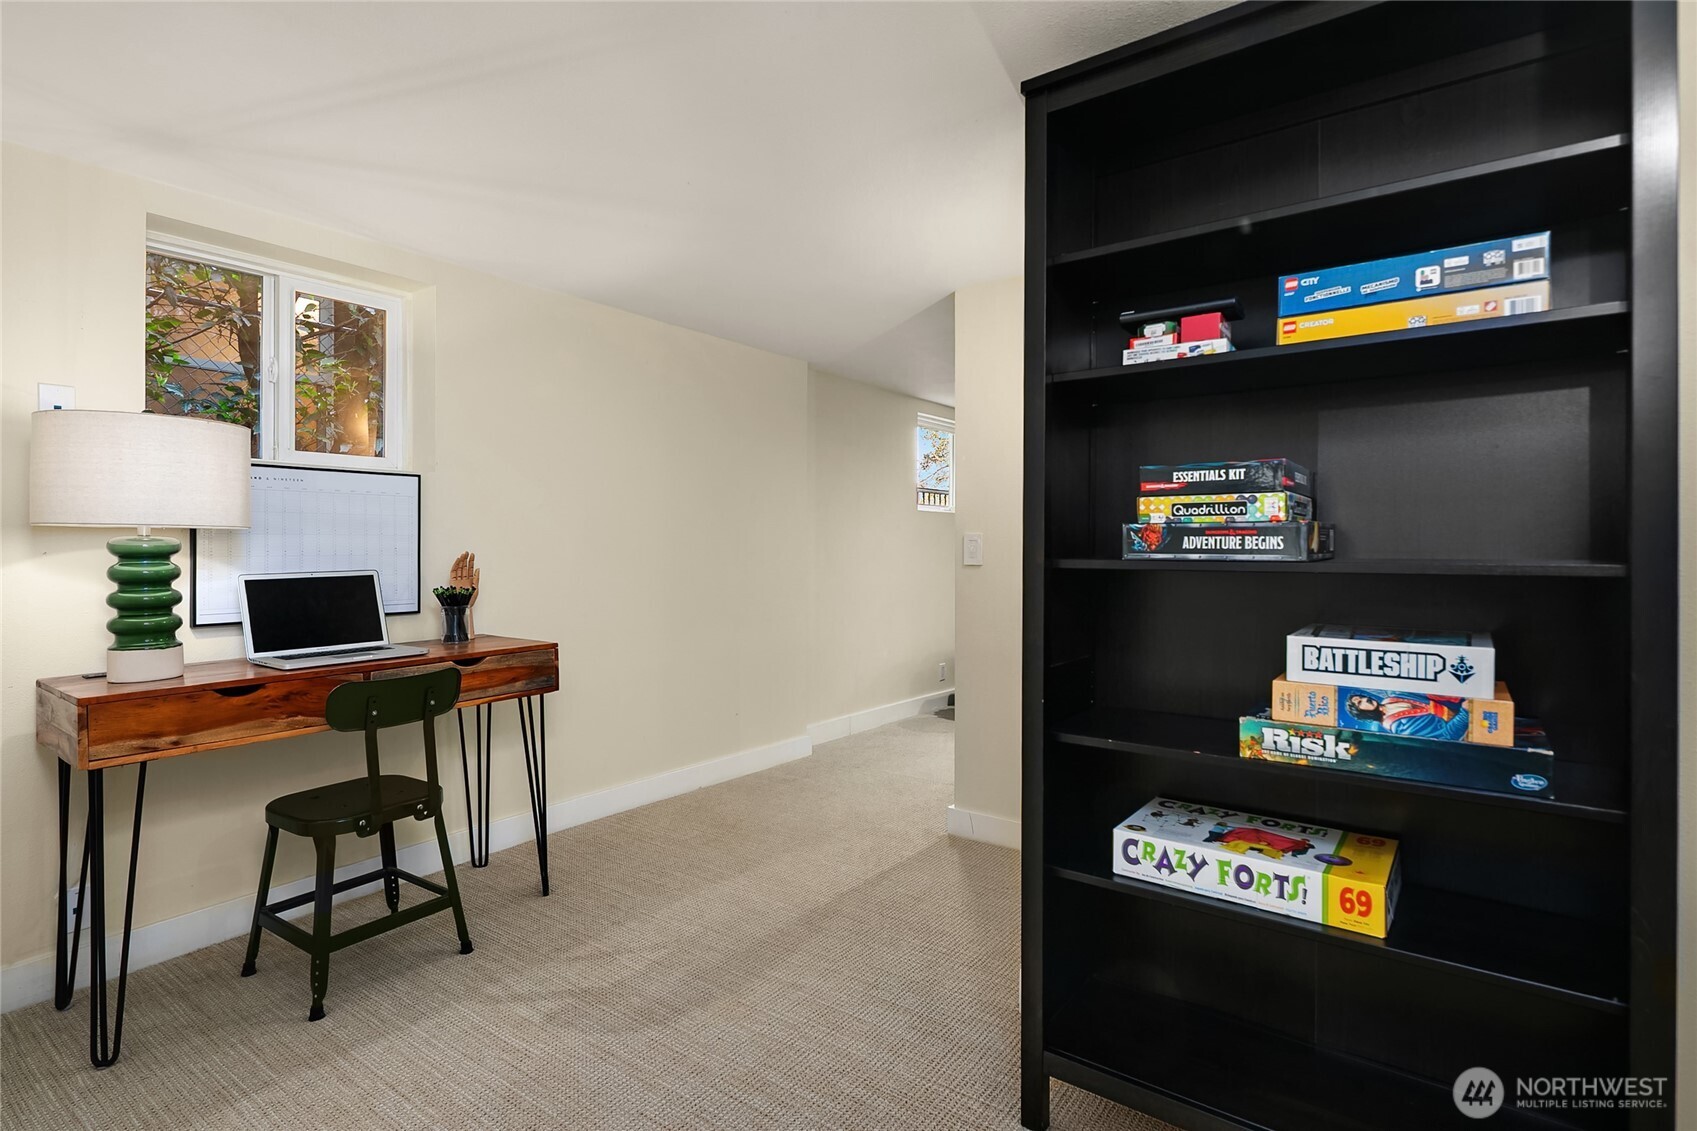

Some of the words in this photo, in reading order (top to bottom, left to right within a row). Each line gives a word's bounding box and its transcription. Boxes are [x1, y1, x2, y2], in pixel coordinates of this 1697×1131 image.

[1300, 276, 1319, 286] CITY
[1299, 318, 1334, 329] CREATOR
[1172, 468, 1226, 483] ESSENTIALS
[1229, 468, 1246, 480] KIT
[1172, 502, 1247, 517] Quadrillion
[1182, 535, 1242, 550] ADVENTURE
[1244, 535, 1284, 550] BEGINS
[1302, 645, 1445, 681] BATTLESHIP
[1304, 691, 1316, 718] Puerto
[1316, 695, 1329, 717] Rico
[1157, 800, 1239, 819] CRAZY
[1356, 836, 1387, 847] 69
[1121, 838, 1209, 881] CRAZY
[1216, 858, 1308, 905] FORTS!
[1339, 886, 1373, 918] 69
